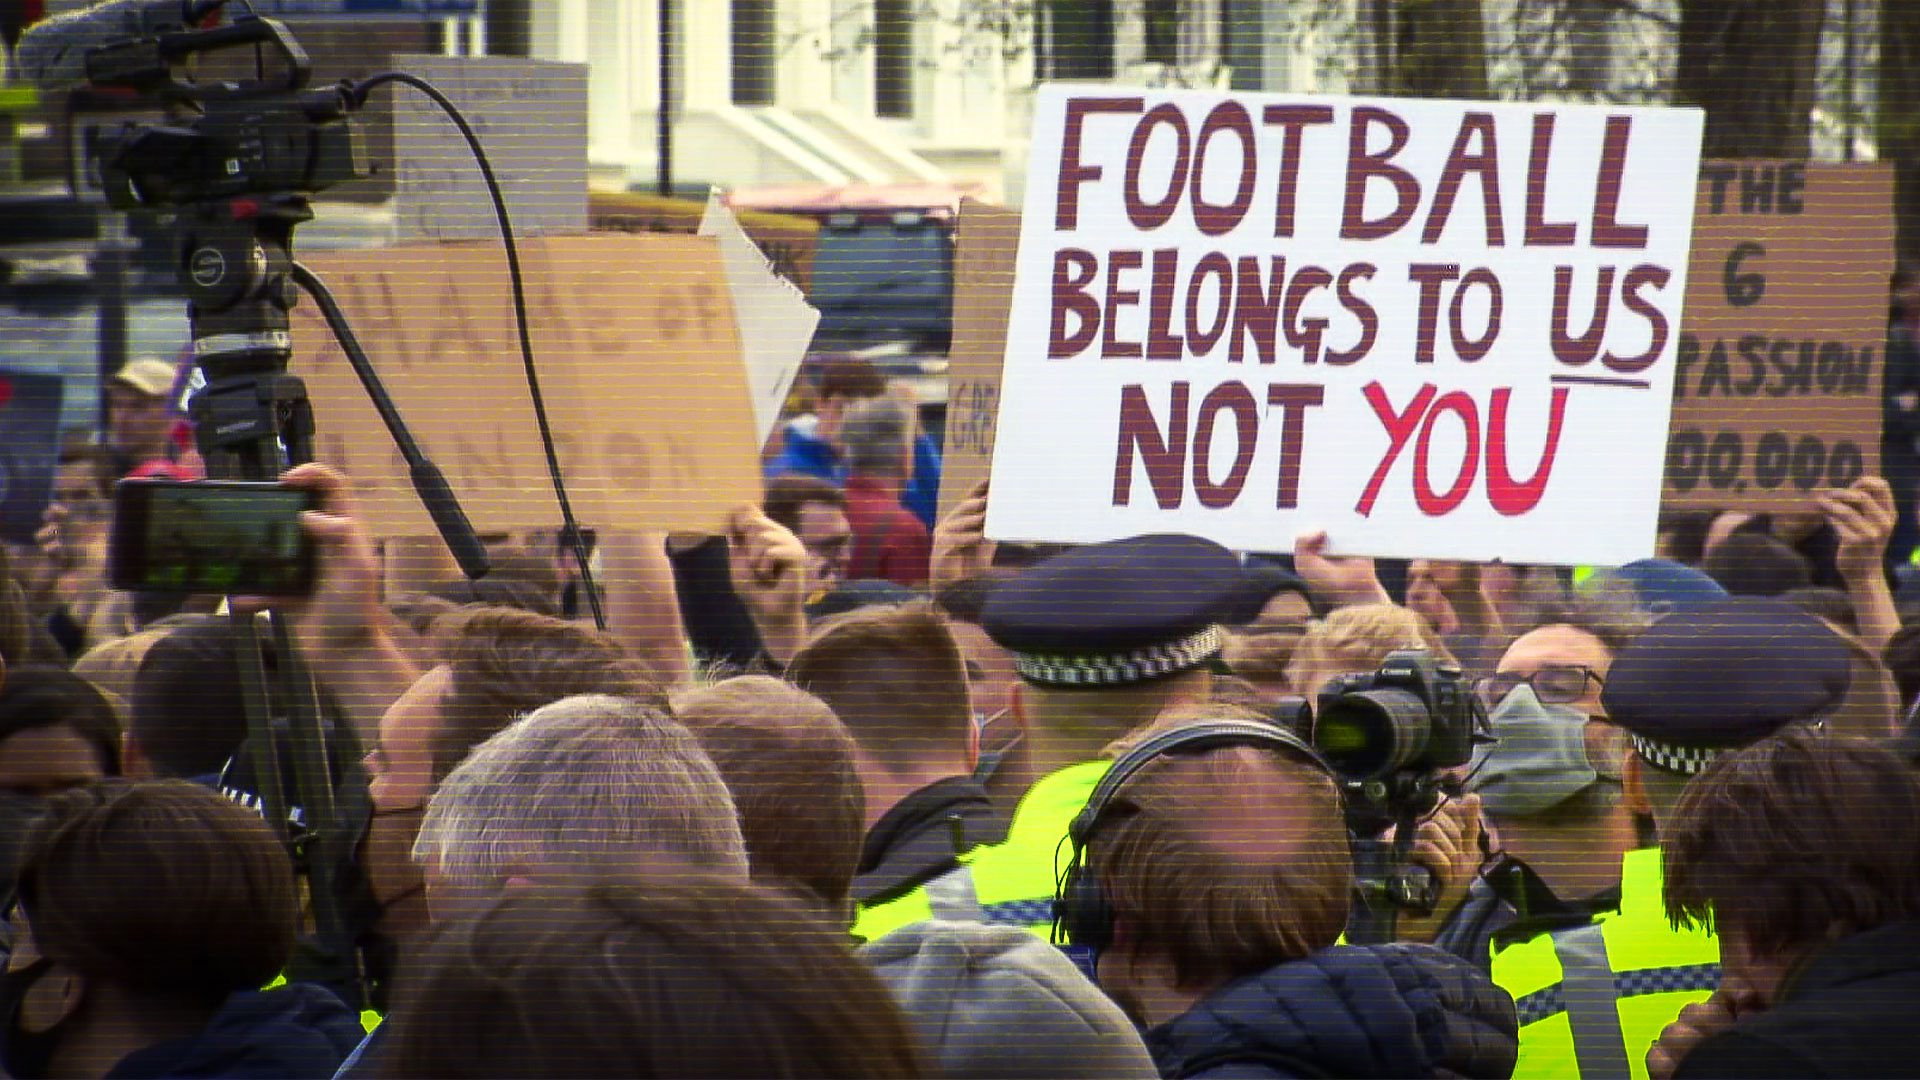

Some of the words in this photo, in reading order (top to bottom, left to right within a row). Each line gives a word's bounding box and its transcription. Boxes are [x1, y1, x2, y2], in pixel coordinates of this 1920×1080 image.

[1056, 98, 1648, 248] FOOTBALL
[1700, 164, 1804, 215] THE
[1048, 249, 1378, 365] BELONGS
[1409, 264, 1502, 363] TO
[1551, 265, 1670, 374] US
[1674, 334, 1873, 398] PASSION
[1113, 381, 1325, 509] NOT
[1355, 381, 1568, 517] YOU
